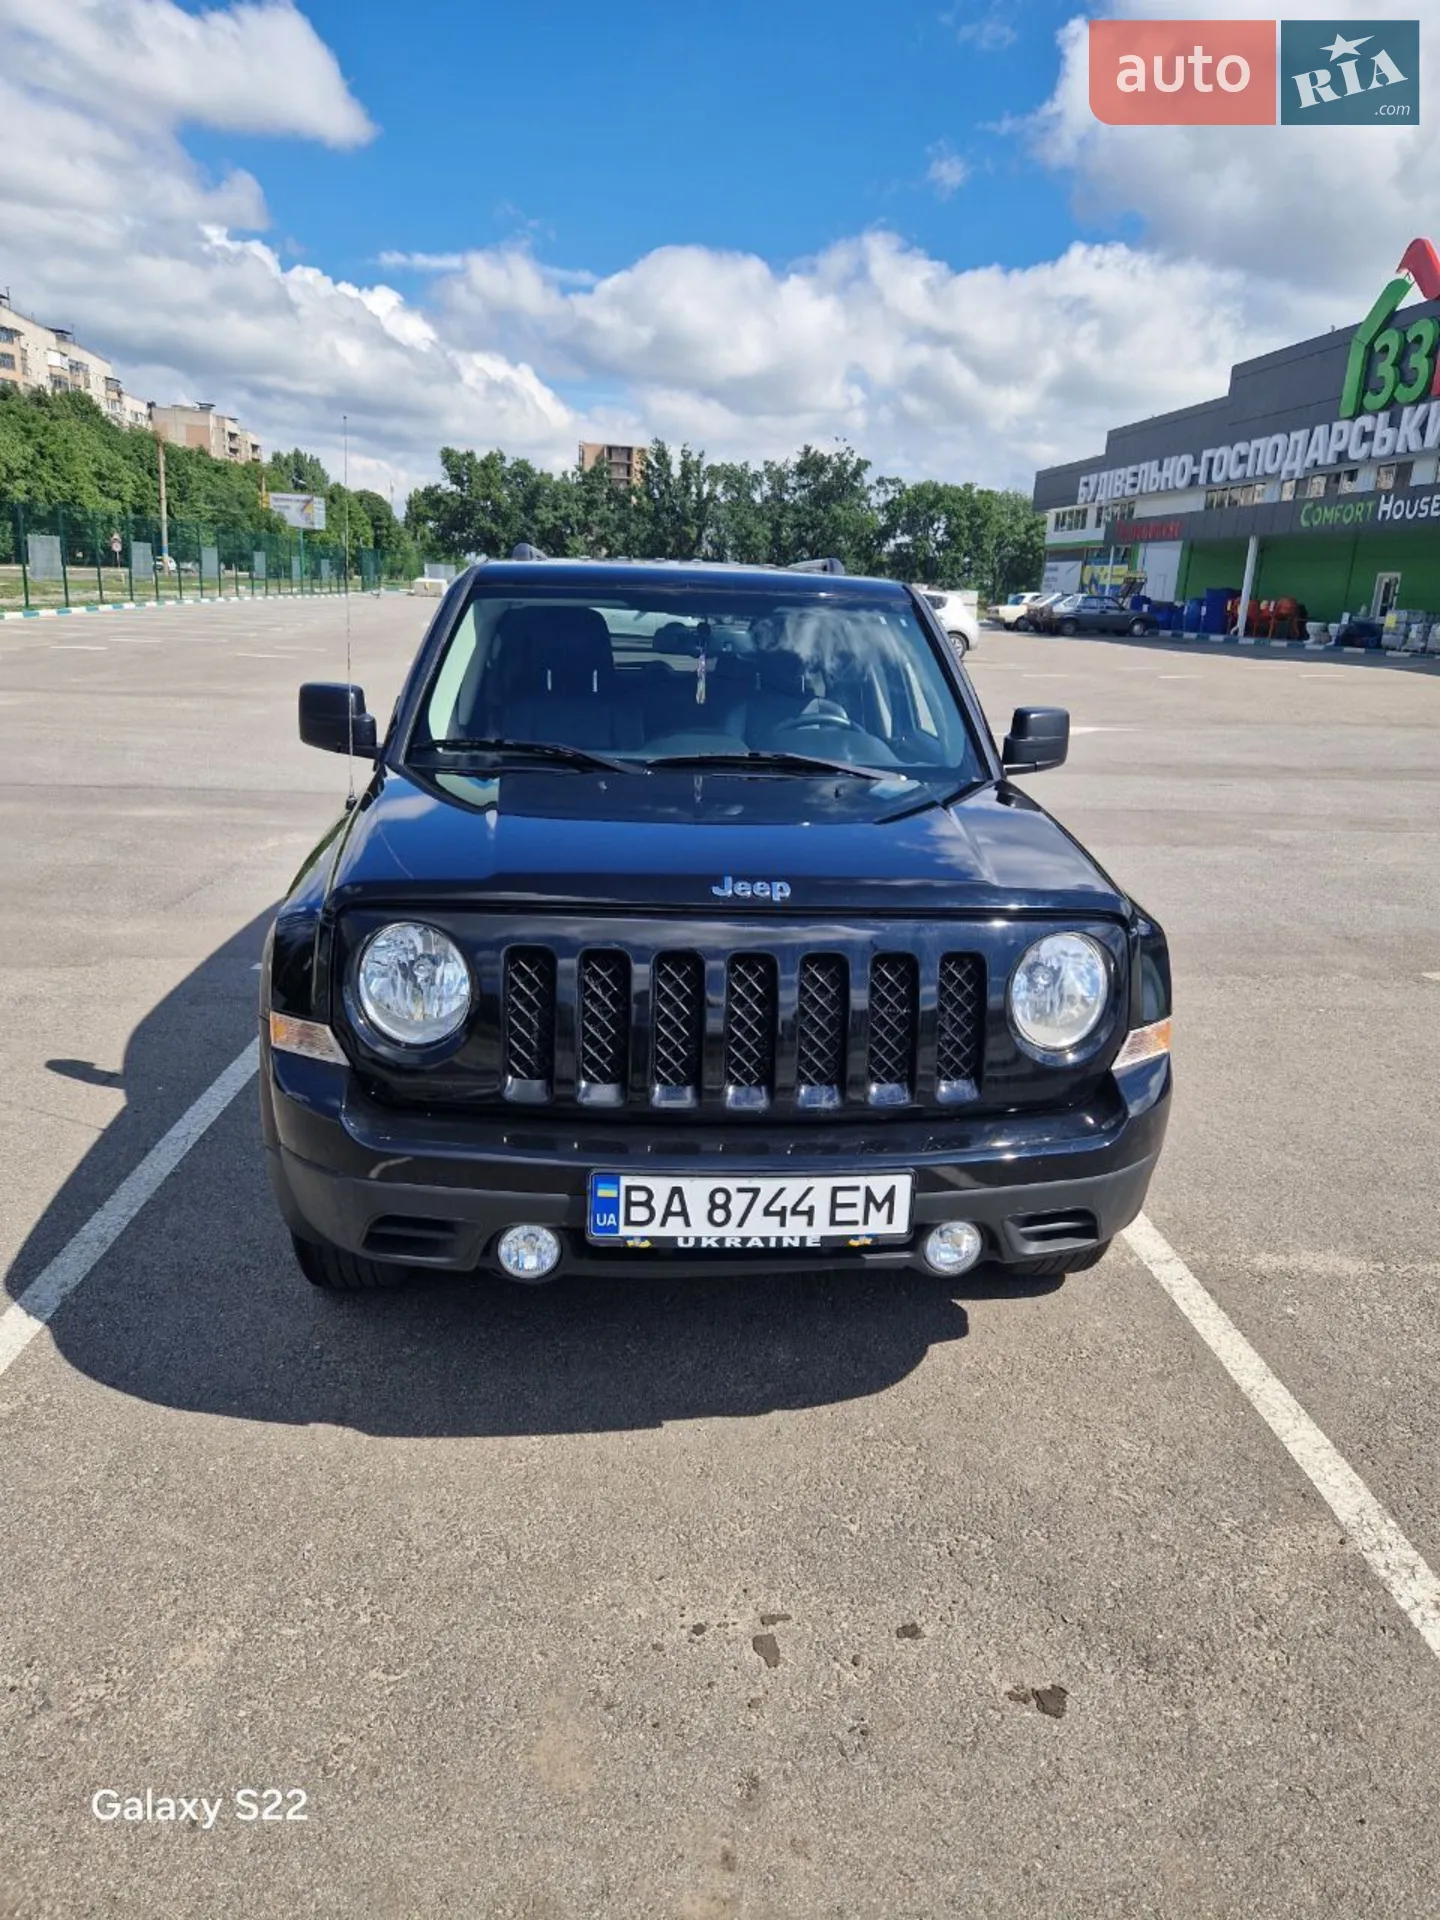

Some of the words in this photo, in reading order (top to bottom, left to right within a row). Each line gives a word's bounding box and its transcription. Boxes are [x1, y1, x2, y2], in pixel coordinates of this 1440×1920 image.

[1377, 493, 1440, 522] HOUSE
[711, 876, 791, 901] Jeep
[624, 1184, 691, 1228] BA
[707, 1186, 816, 1228] 8744
[829, 1184, 897, 1227] EM
[596, 1214, 617, 1226] UA
[677, 1235, 822, 1248] UKRAINE
